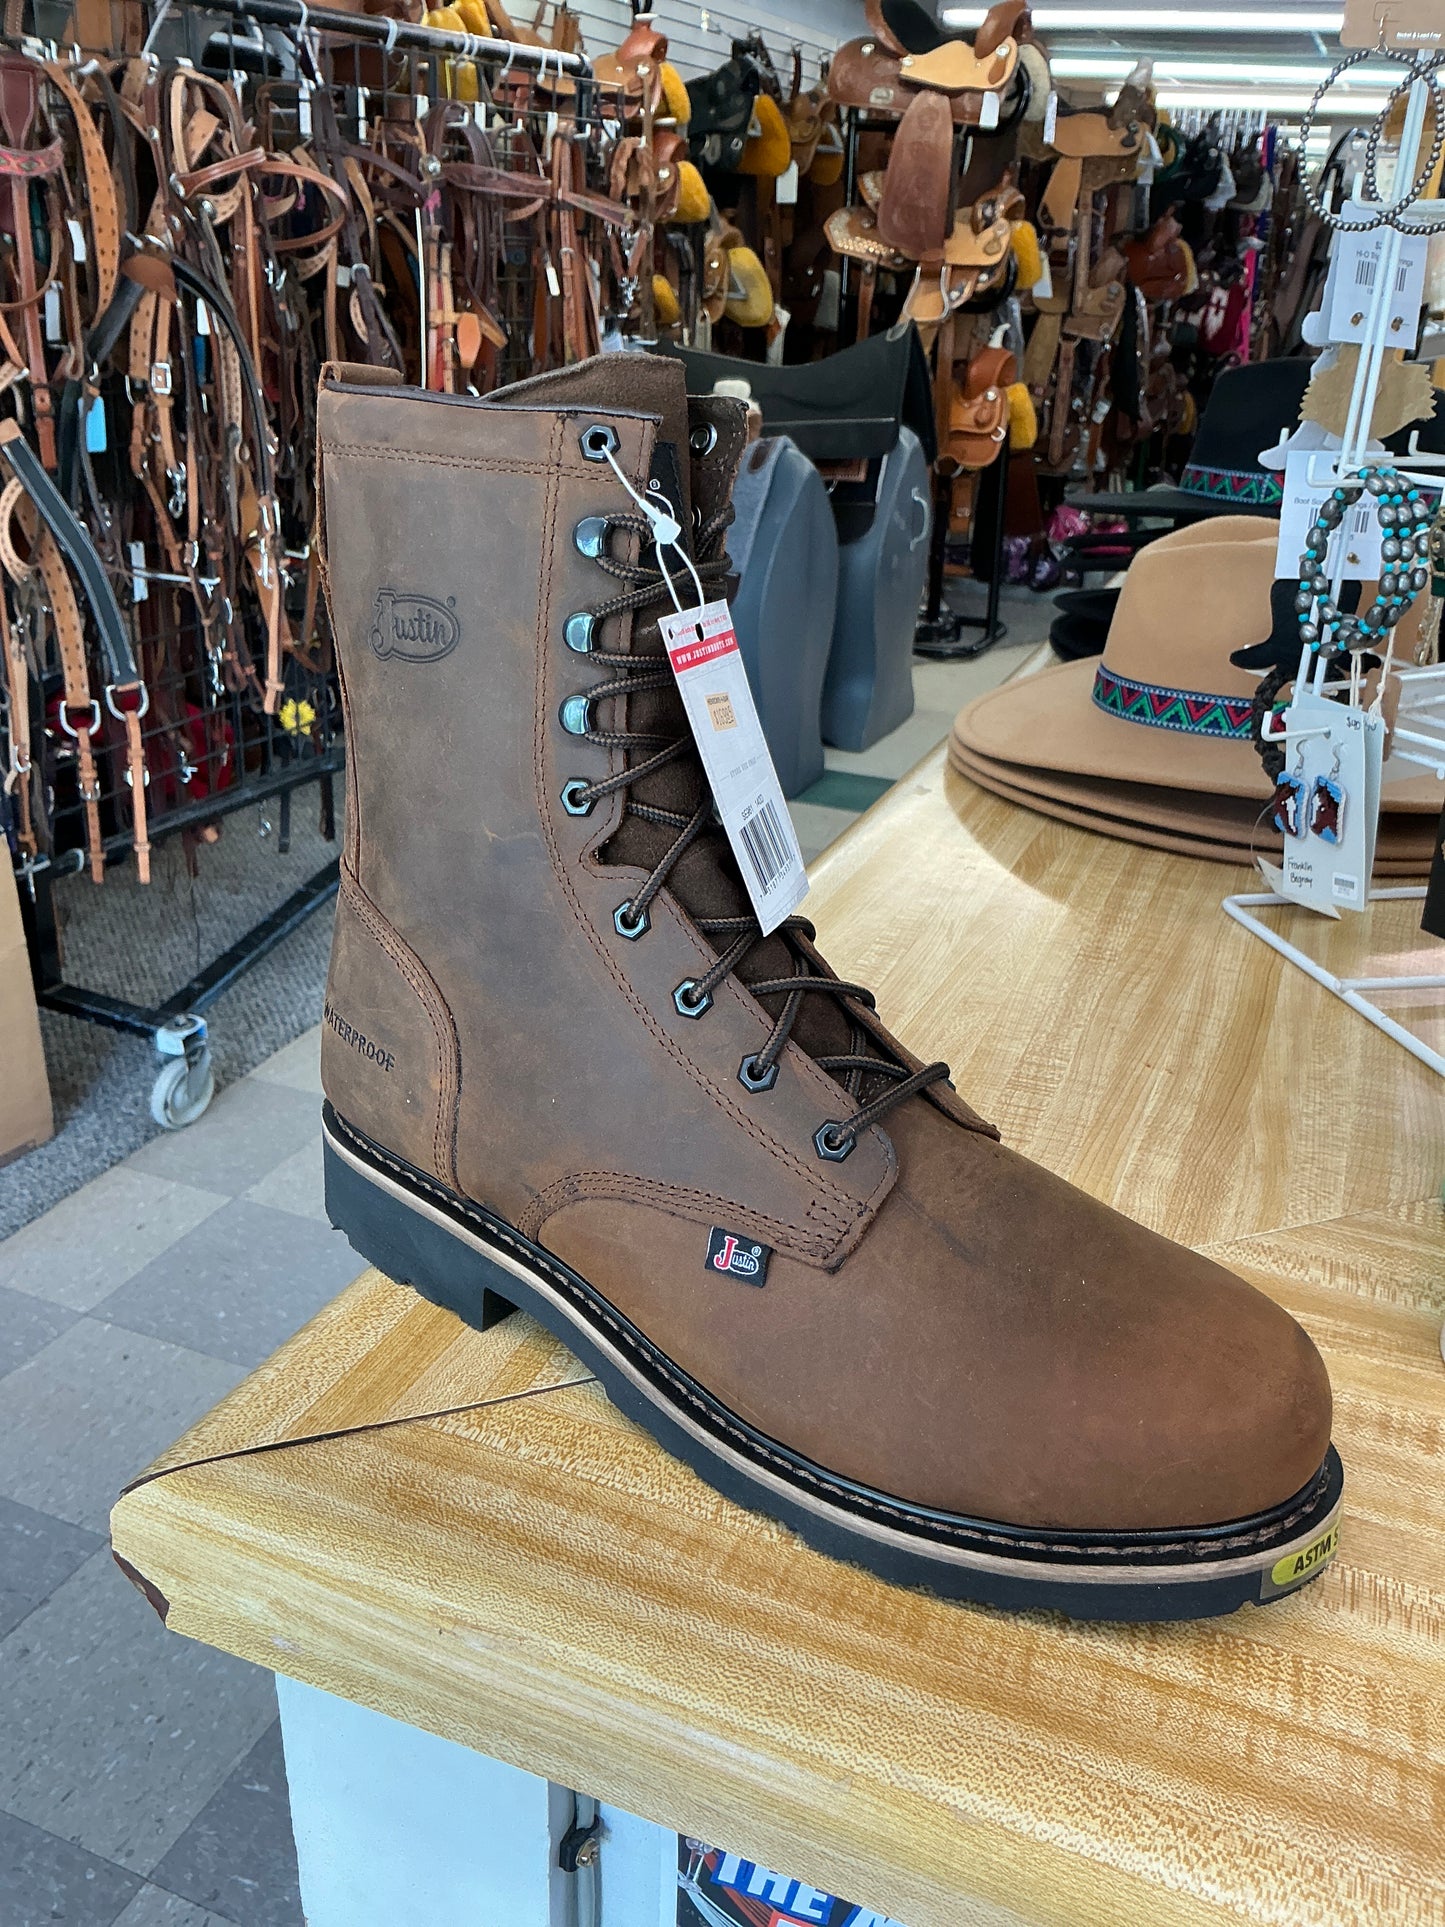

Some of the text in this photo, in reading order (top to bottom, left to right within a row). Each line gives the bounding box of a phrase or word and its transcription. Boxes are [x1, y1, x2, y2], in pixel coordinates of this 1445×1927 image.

[371, 588, 448, 658] Justin
[713, 1235, 755, 1271] Justin
[1293, 1534, 1332, 1575] ASTM
